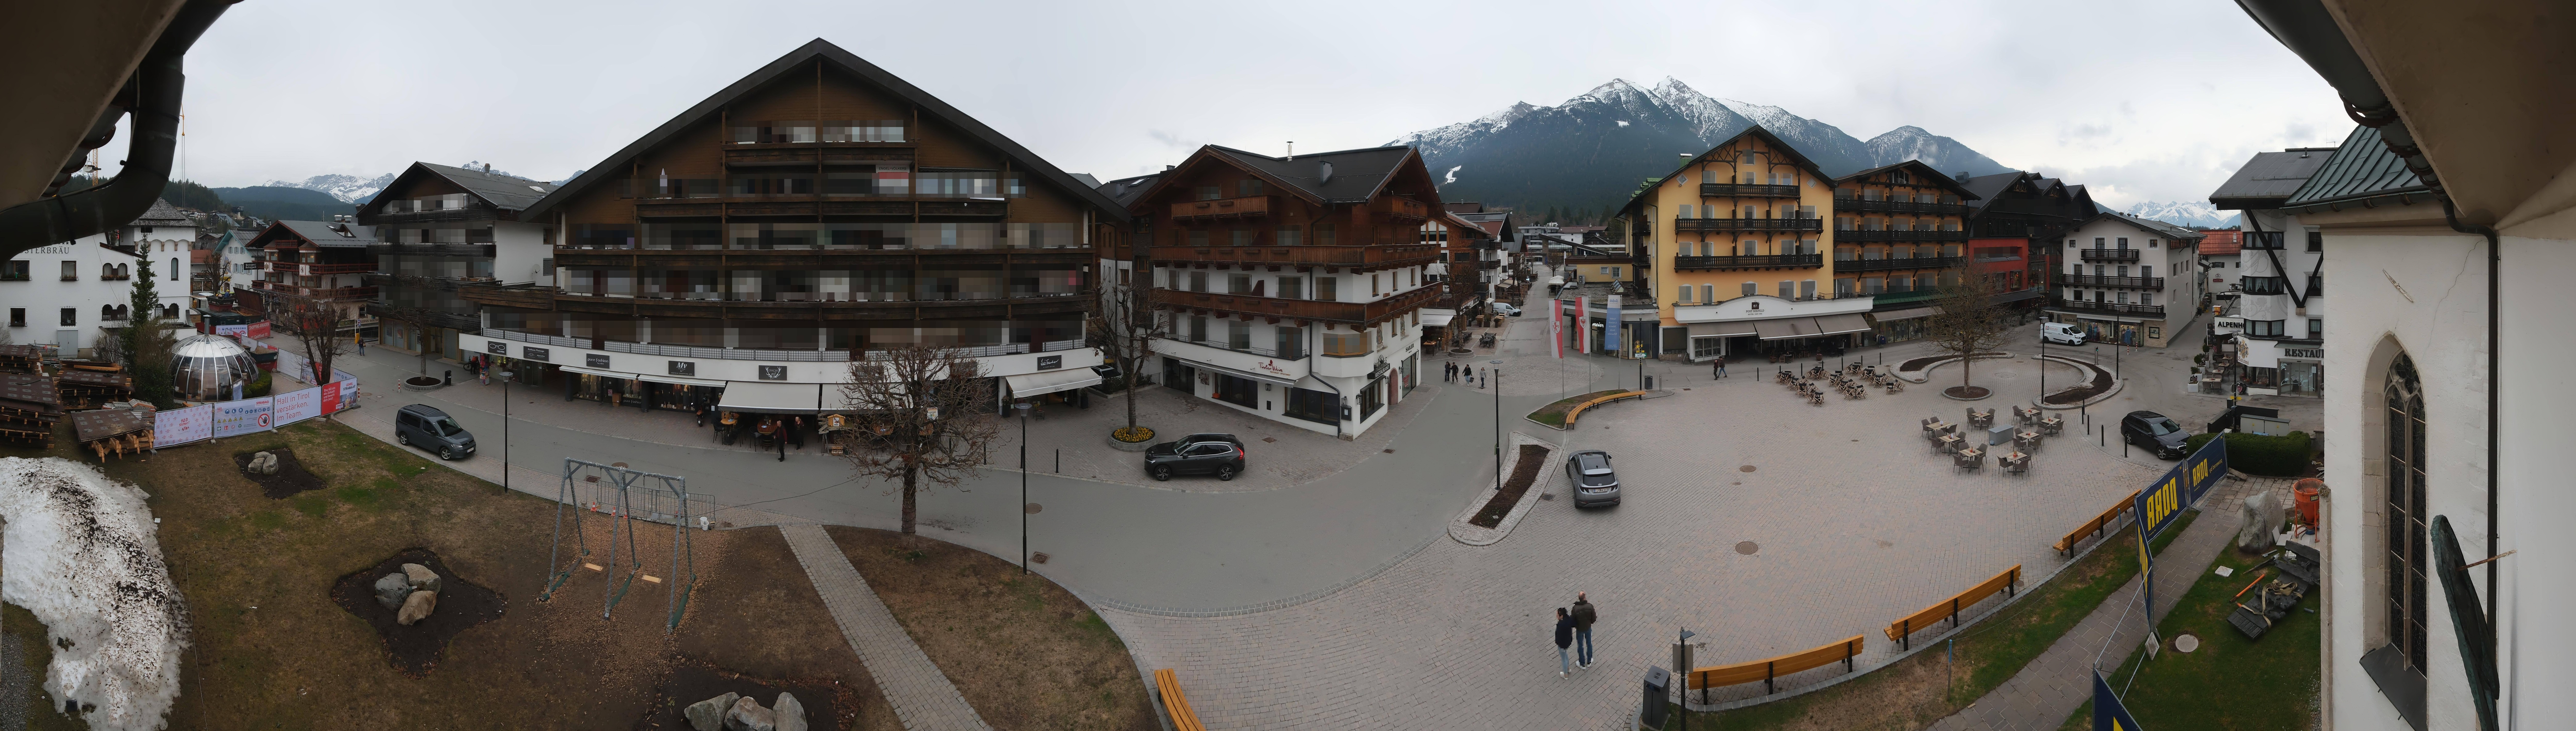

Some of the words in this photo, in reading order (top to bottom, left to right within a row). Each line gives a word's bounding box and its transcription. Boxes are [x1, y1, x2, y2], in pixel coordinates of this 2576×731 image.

[1406, 343, 1414, 352] SAILER
[1375, 365, 1389, 378] RESTAURANT
[277, 396, 289, 405] Hall
[277, 402, 308, 413] verstärken.
